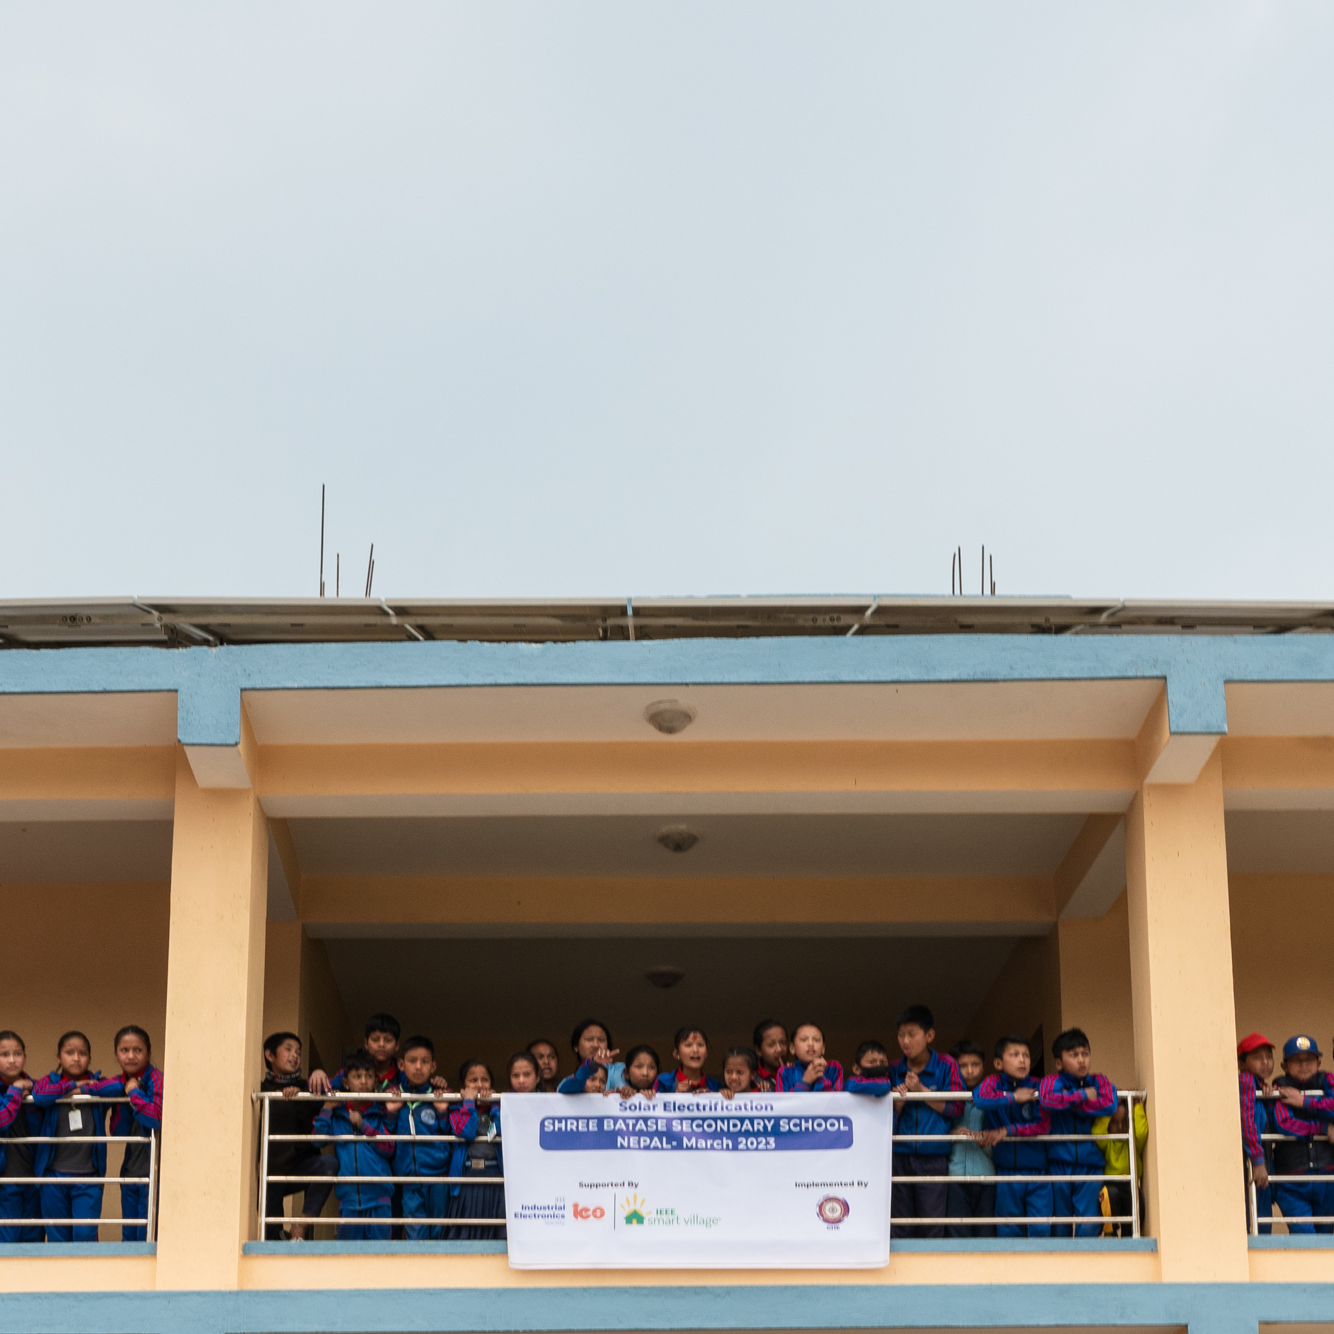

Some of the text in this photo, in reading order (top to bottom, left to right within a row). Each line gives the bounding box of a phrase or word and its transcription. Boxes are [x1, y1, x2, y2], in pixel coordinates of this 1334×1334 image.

[619, 1100, 774, 1112] Solar Electrification
[544, 1118, 849, 1132] SHREE BATASE SECONDARY SCHOOL
[617, 1135, 776, 1150] NEPAL- March 2023
[578, 1181, 639, 1190] Supported By
[794, 1180, 869, 1190] Implemented By
[521, 1203, 566, 1211] Industrial
[655, 1208, 676, 1216] IEEE
[513, 1211, 566, 1219] Electronics
[647, 1214, 719, 1229] smart village
